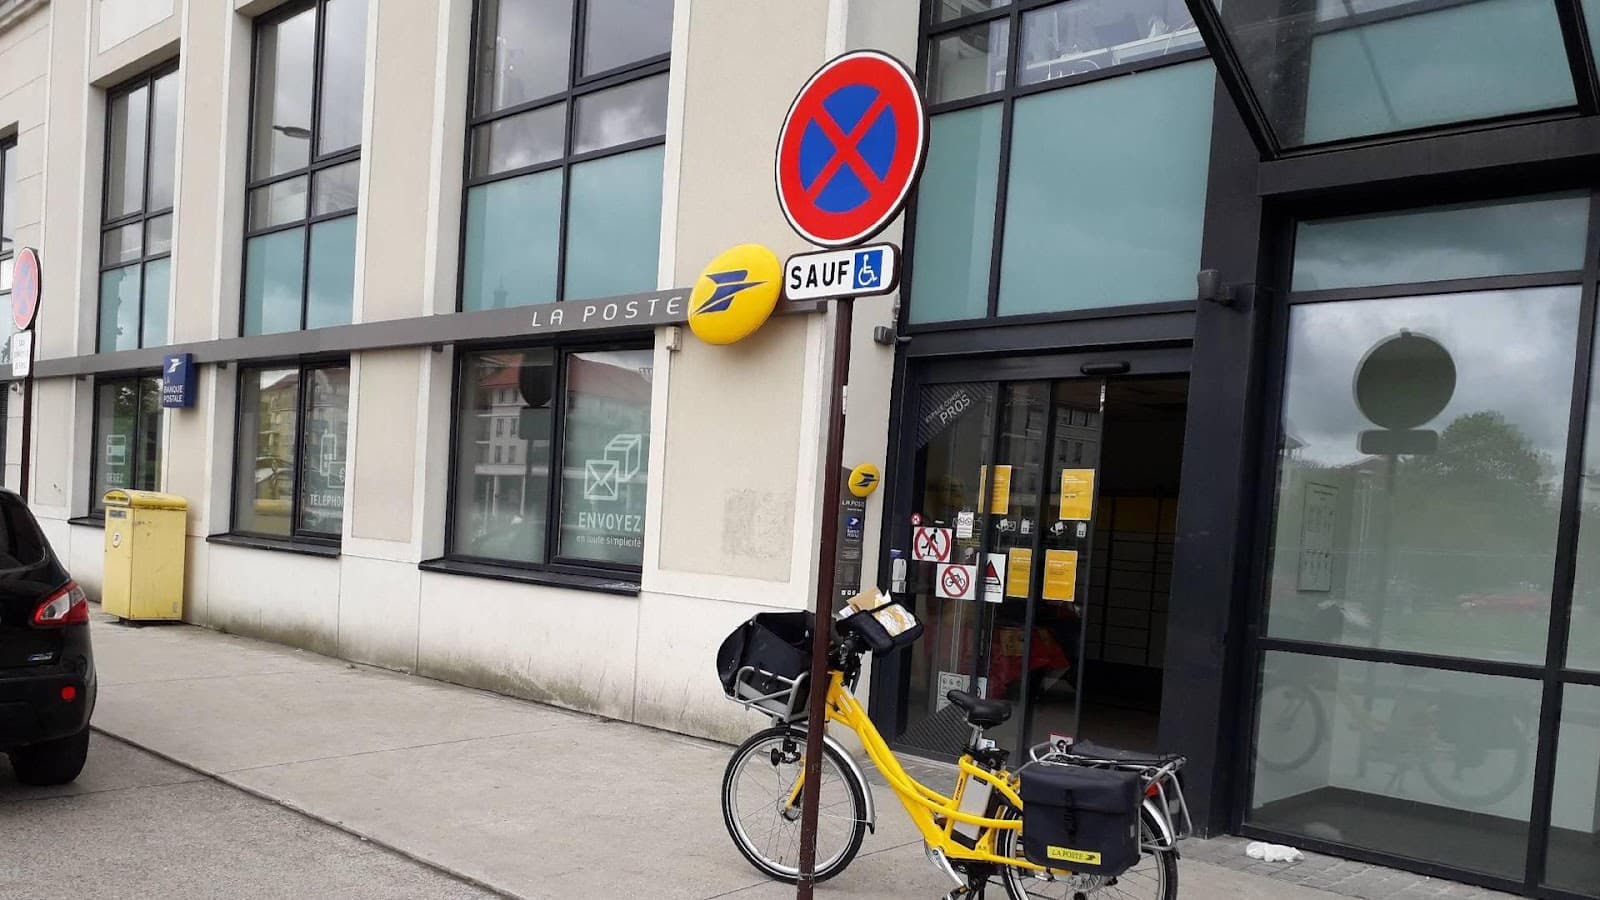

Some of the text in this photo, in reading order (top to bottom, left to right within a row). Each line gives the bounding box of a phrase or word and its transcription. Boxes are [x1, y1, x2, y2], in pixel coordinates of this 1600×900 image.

[790, 260, 850, 290] SAUF
[531, 296, 683, 327] LA POSTE
[163, 385, 184, 394] BANQUE
[163, 394, 184, 403] POSTALE
[939, 394, 970, 425] PROS
[578, 511, 642, 532] ENVOYEZ
[606, 535, 642, 549] simplicité
